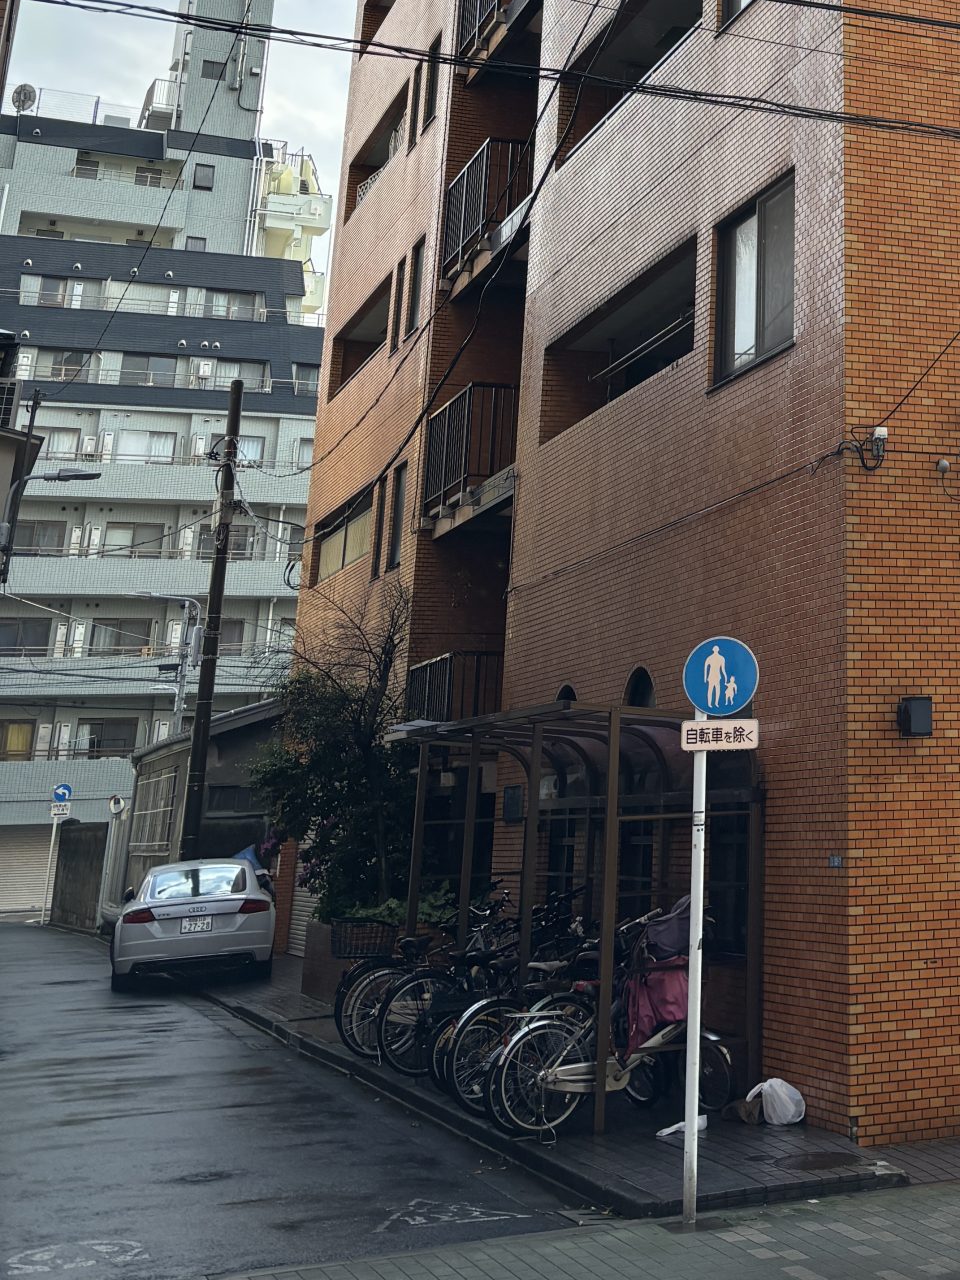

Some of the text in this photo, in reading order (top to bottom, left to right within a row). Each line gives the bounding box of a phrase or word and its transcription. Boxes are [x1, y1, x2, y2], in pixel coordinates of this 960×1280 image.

[686, 726, 754, 744] 自転車を除く
